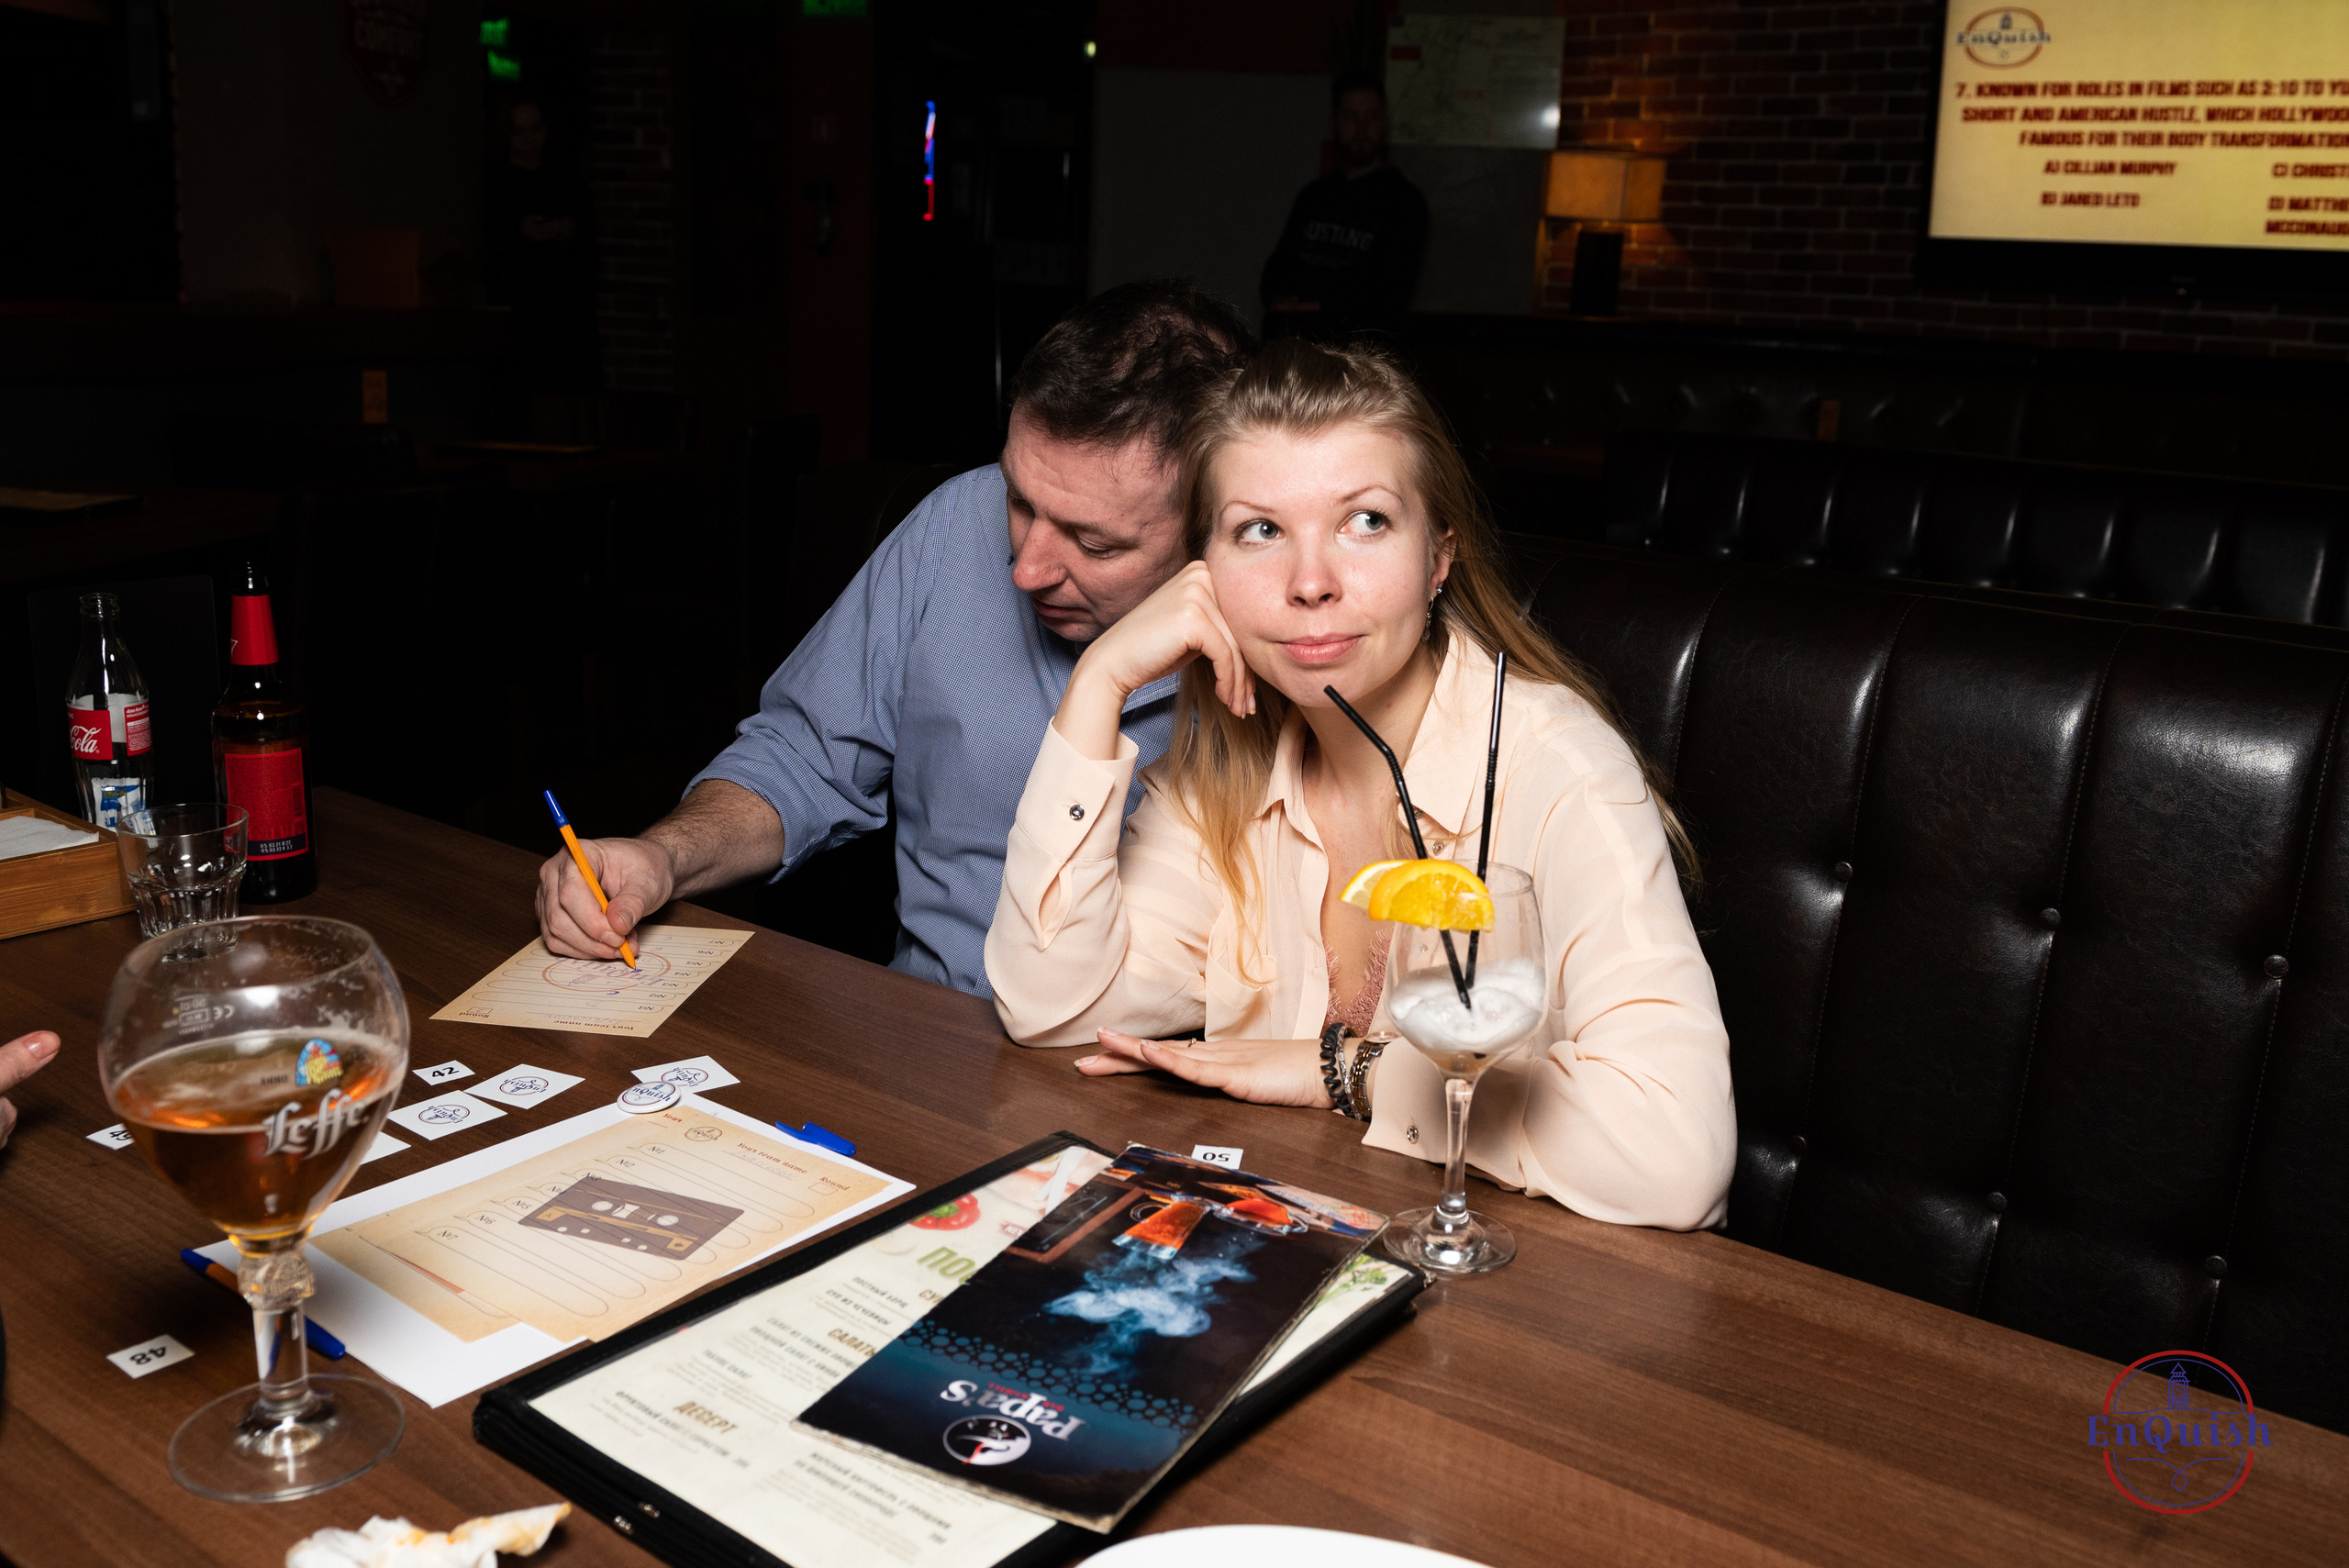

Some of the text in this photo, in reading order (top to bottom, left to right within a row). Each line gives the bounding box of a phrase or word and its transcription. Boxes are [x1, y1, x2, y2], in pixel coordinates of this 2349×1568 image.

[1955, 30, 2051, 46] EnQuish
[1977, 83, 2037, 96] KNOWN
[2043, 83, 2072, 96] FOR
[2077, 83, 2123, 96] ROLES
[2129, 83, 2143, 96] IN
[2148, 82, 2190, 96] FILMS
[2196, 82, 2233, 96] SUCH
[2239, 81, 2256, 95] AS
[2305, 81, 2323, 95] TO
[1963, 107, 2014, 121] SHORT
[2021, 107, 2054, 121] AND
[2059, 107, 2137, 121] AMERICAN
[2207, 107, 2254, 121] WHICH
[2021, 131, 2084, 146] FAMOUS
[2088, 132, 2117, 146] FOR
[2122, 132, 2164, 146] THEIR
[2169, 133, 2205, 147] BODY
[2064, 161, 2115, 174] CILLIAN
[2121, 161, 2177, 174] MURPHY
[2062, 193, 2103, 206] JARED
[2107, 193, 2140, 207] LETO
[1302, 219, 1375, 252] USTANG
[431, 1066, 460, 1078] 42
[262, 1088, 367, 1161] Leffe
[737, 1142, 807, 1174] Your team name
[818, 1176, 851, 1192] Round
[129, 1346, 167, 1365] 48
[940, 1379, 1086, 1441] Papa's
